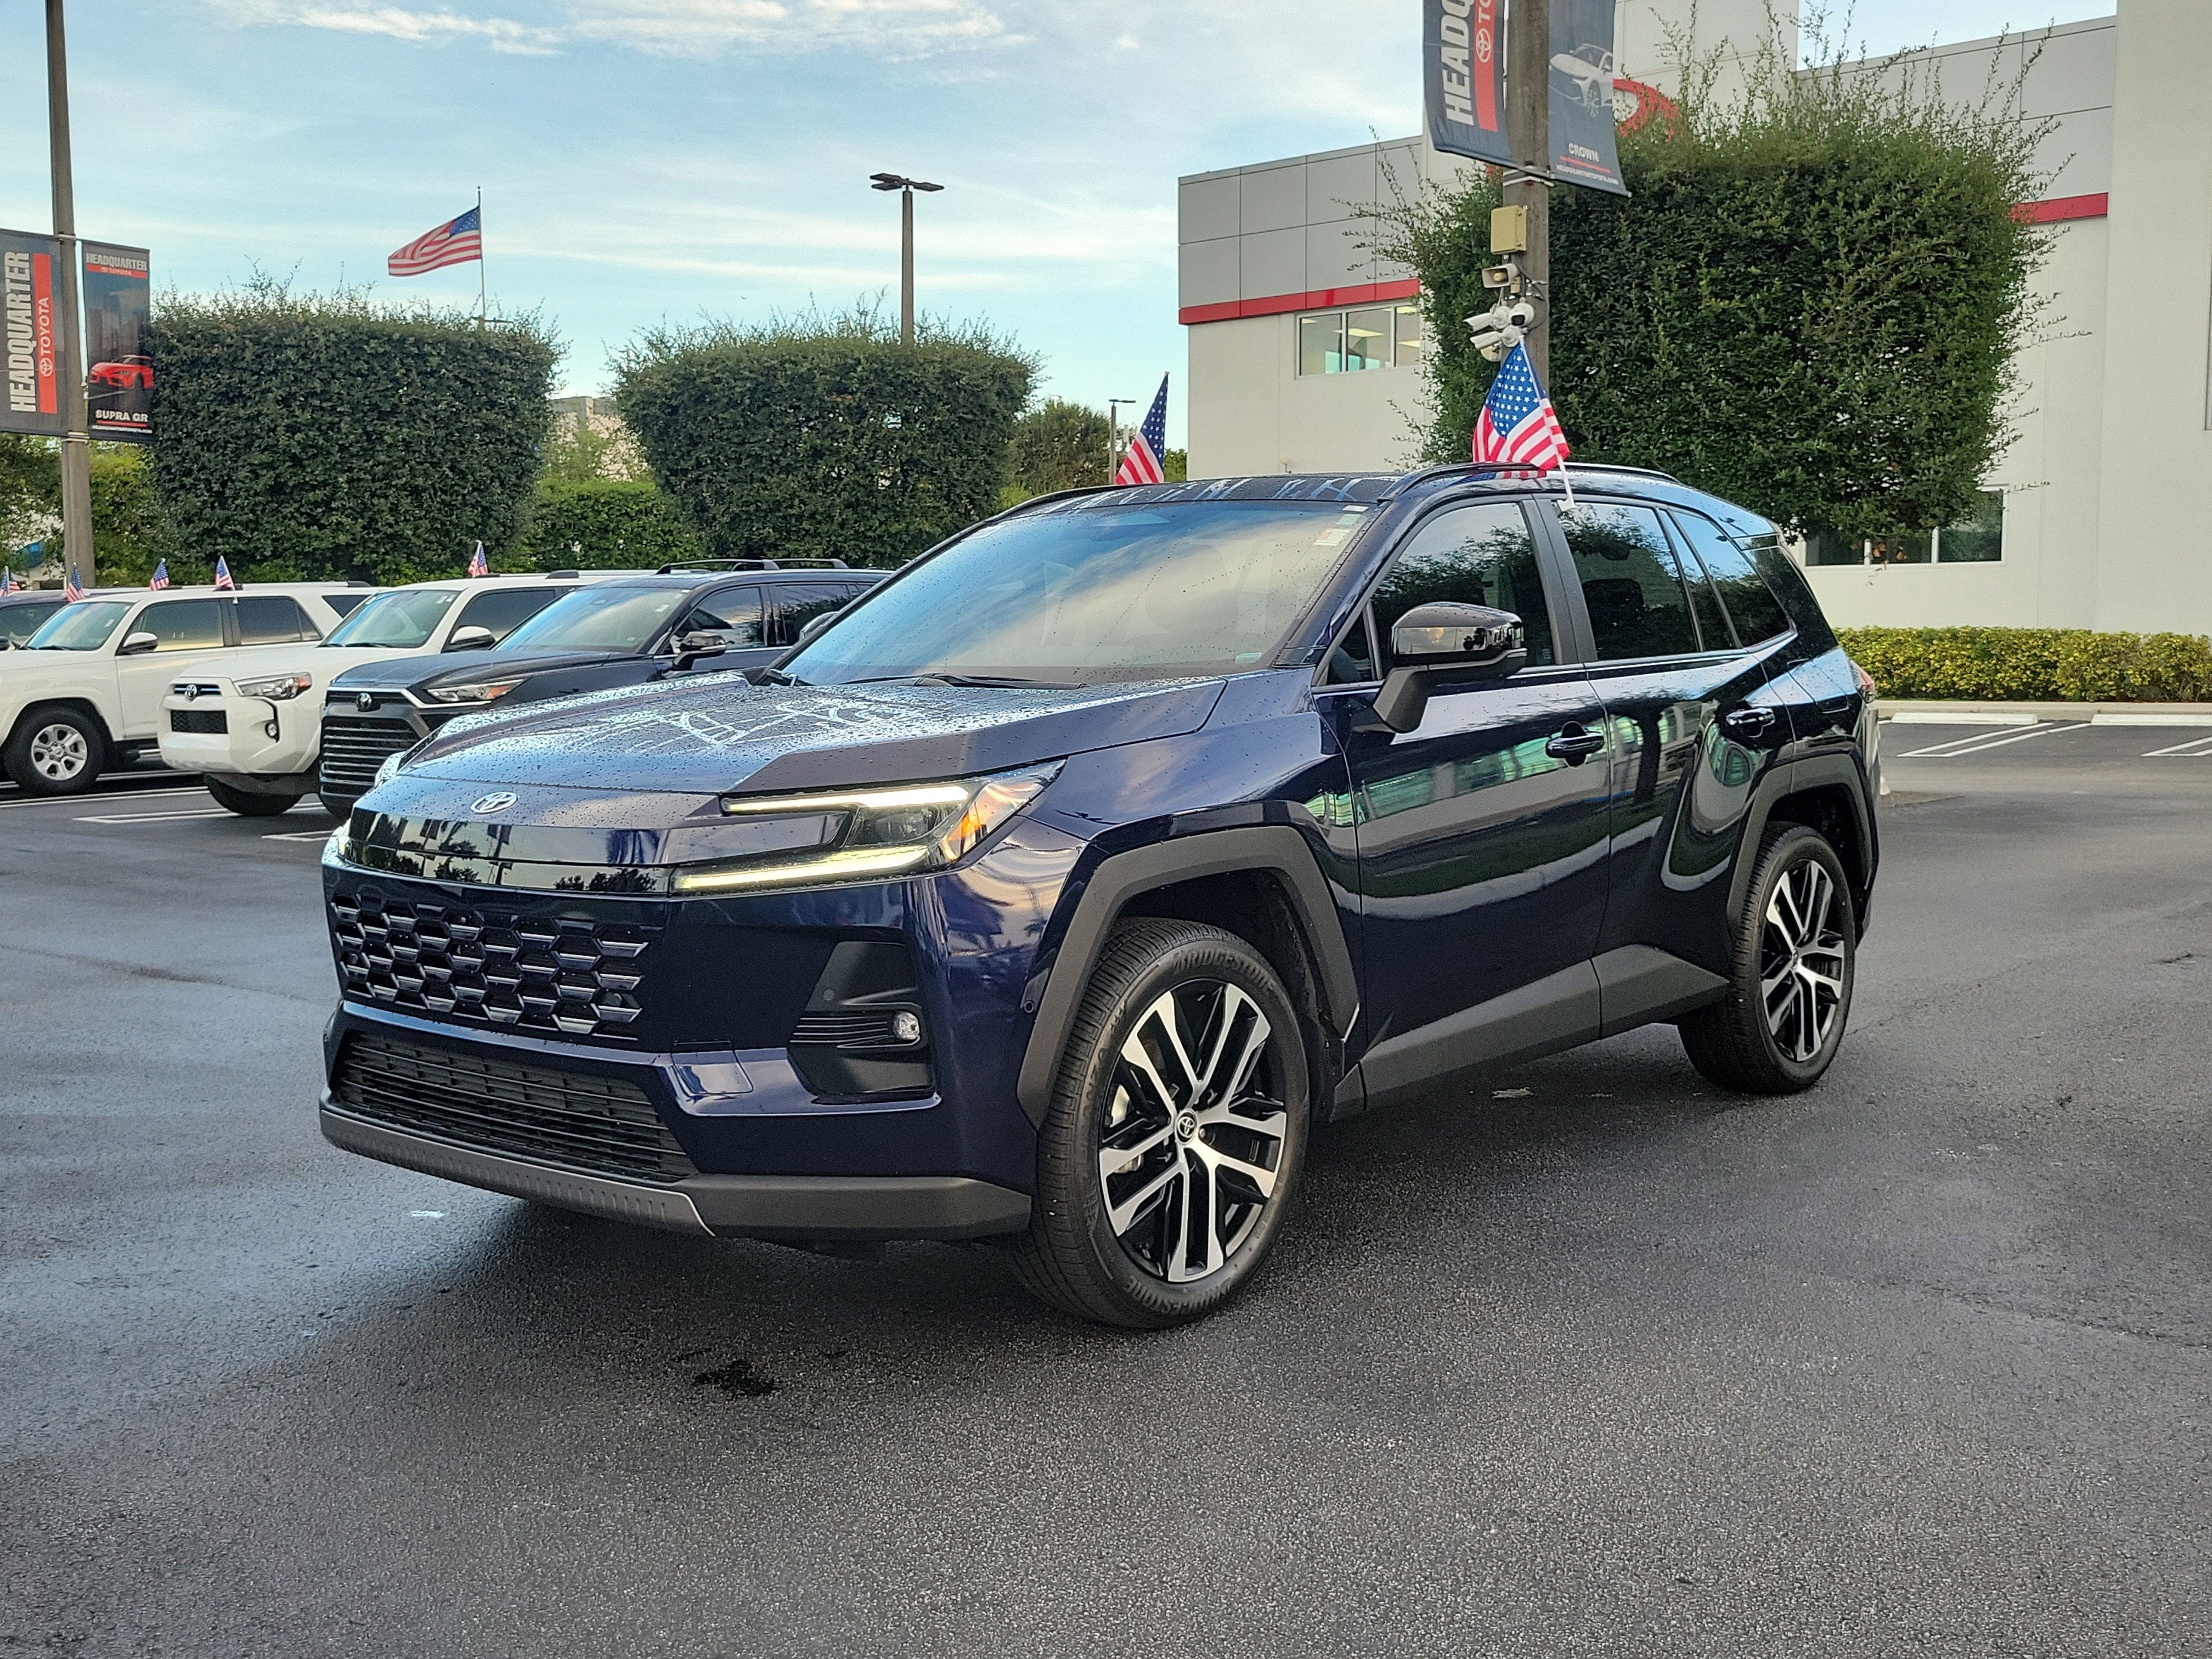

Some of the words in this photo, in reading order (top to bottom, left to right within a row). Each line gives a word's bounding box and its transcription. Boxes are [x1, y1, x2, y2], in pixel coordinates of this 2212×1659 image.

[1568, 143, 1599, 162] CROWN
[86, 253, 148, 271] HEADQUARTER
[109, 268, 132, 276] TOYOTA
[4, 251, 37, 412] HEADQUARTER
[38, 297, 51, 356] TOYOTA
[95, 409, 131, 421] SUPRA
[132, 413, 149, 422] GR
